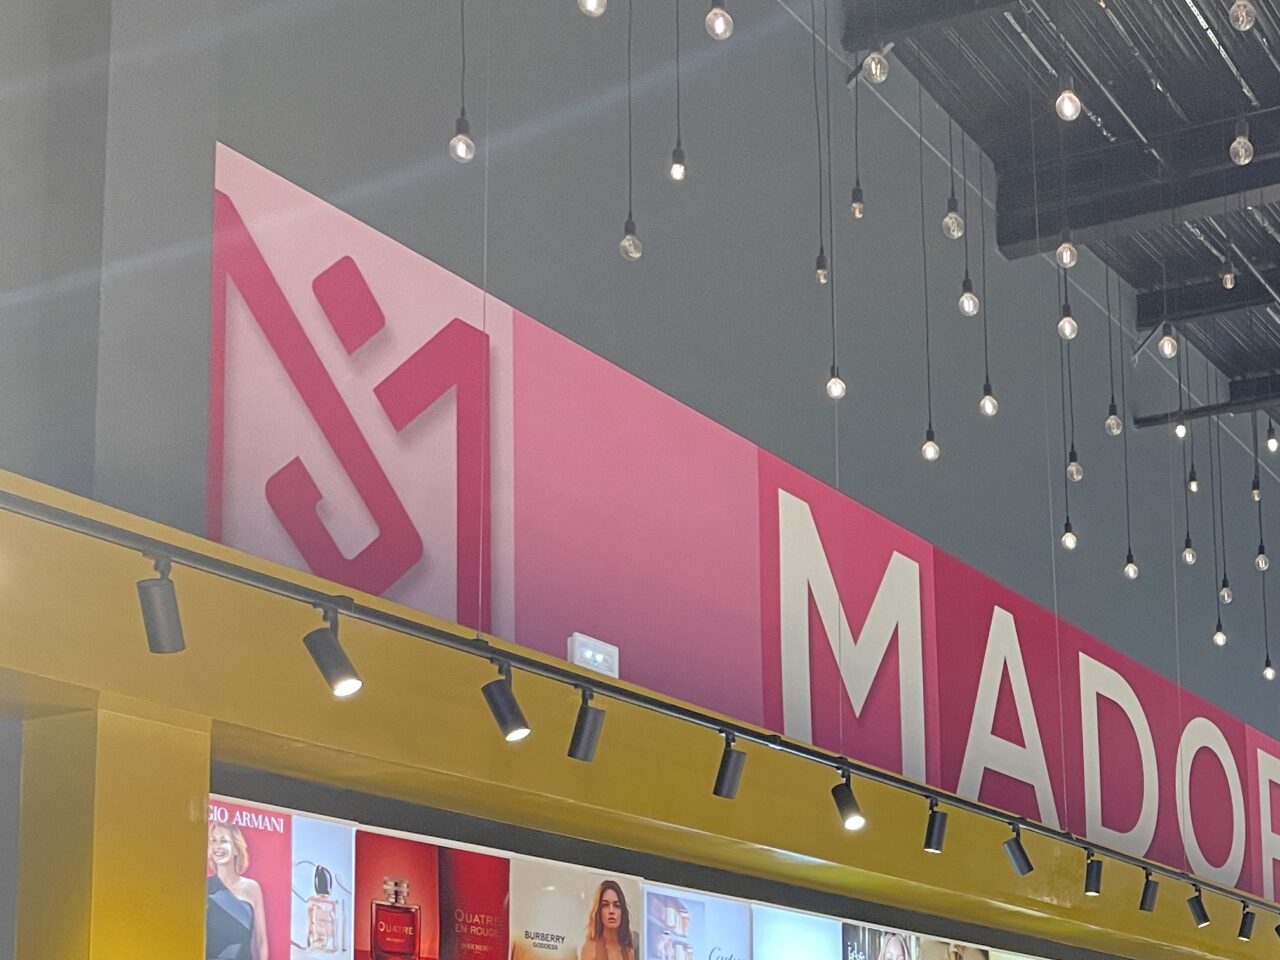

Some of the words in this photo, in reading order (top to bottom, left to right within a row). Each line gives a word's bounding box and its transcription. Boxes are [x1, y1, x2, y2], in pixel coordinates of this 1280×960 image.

[232, 811, 284, 833] ARMANI
[454, 908, 500, 926] QUATRE
[378, 921, 414, 936] QUATRE
[524, 930, 566, 944] BURBERRY
[532, 941, 559, 951] GODDESS
